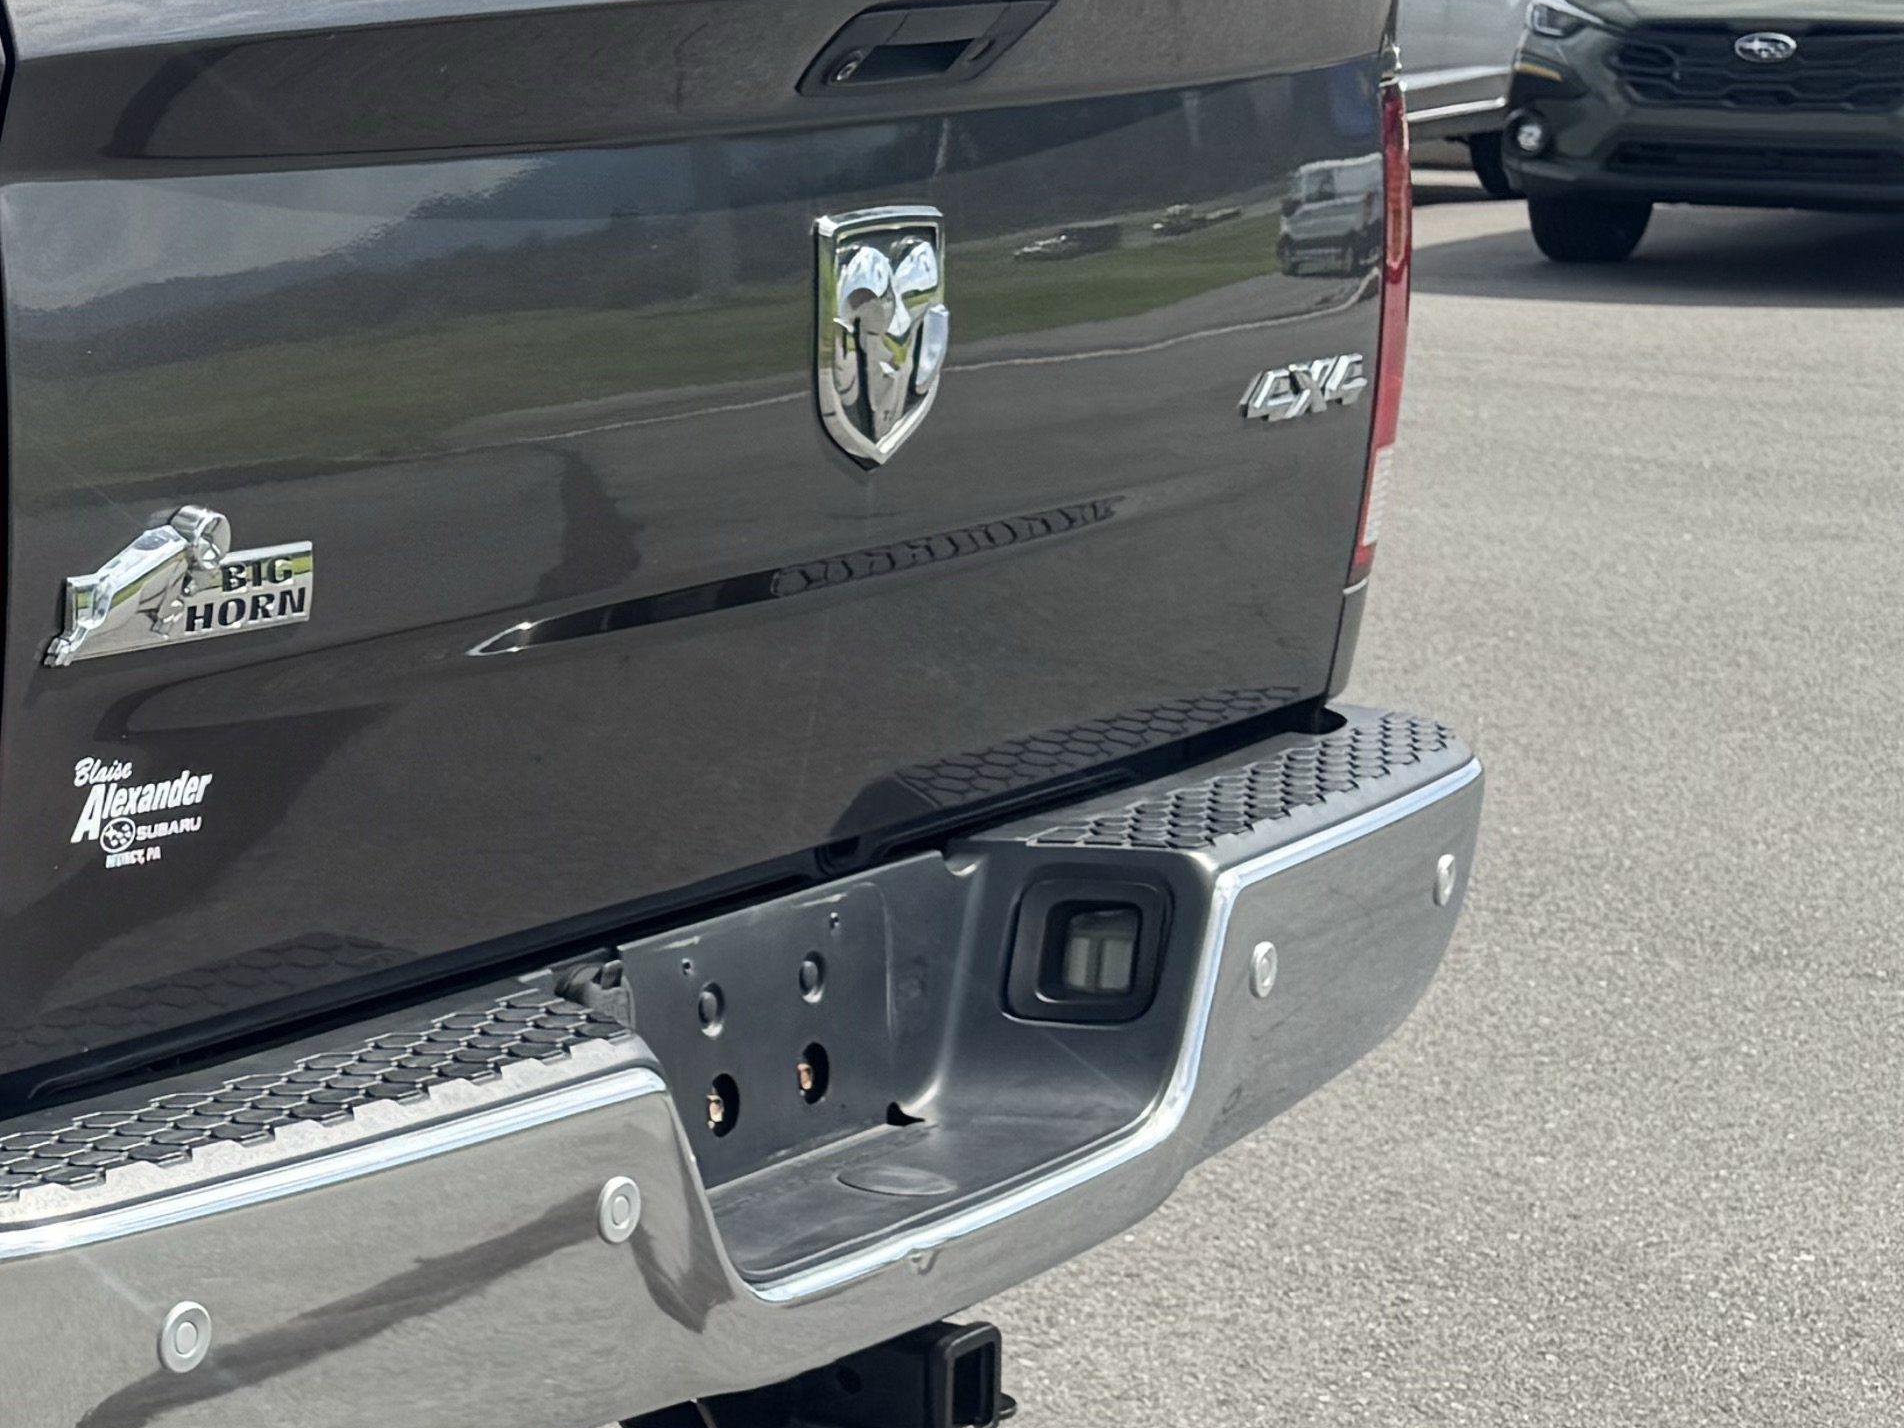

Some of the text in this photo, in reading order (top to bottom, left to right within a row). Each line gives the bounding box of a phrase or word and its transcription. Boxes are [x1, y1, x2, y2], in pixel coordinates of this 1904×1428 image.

[221, 556, 294, 593] BIG
[185, 586, 306, 633] HORN
[73, 756, 133, 787] Blaise
[70, 770, 213, 844] Alexander
[135, 816, 202, 841] SUBARU
